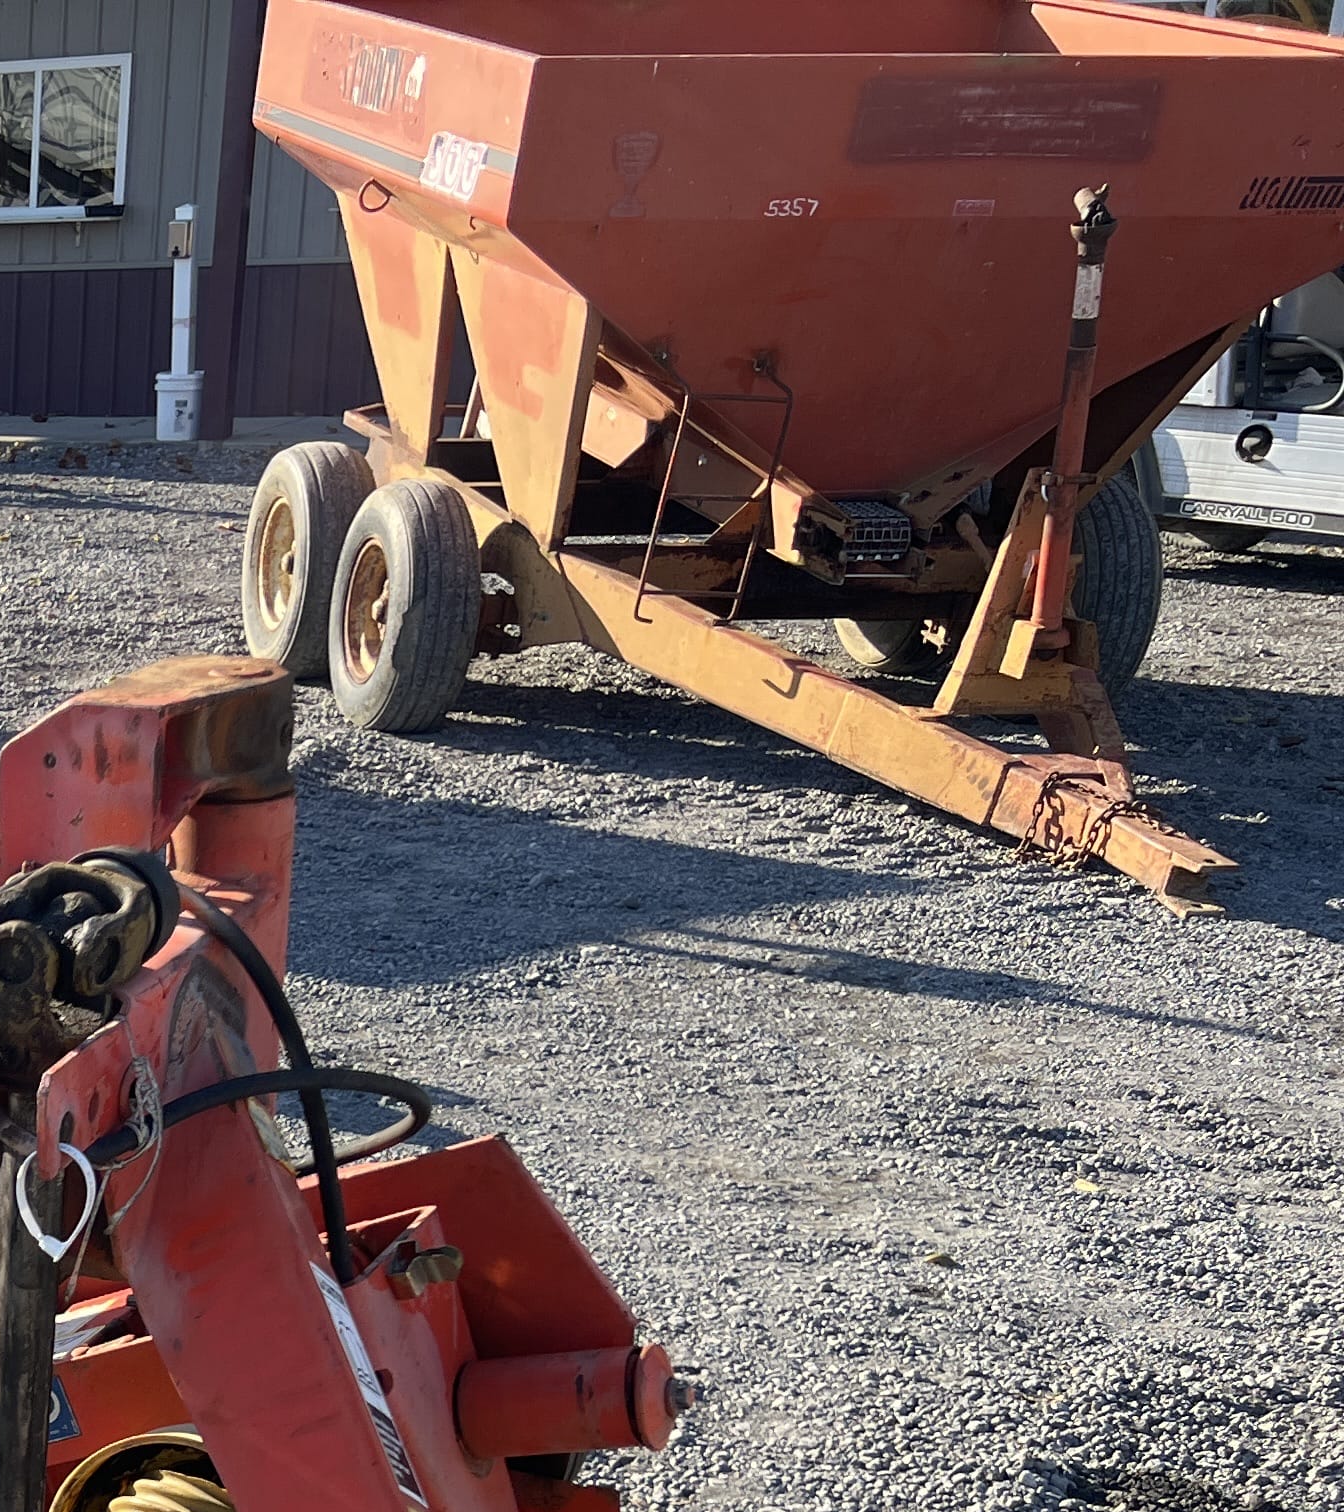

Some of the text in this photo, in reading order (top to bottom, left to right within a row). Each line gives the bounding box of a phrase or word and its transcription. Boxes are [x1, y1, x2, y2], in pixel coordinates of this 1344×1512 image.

[764, 198, 819, 217] 5357
[1181, 501, 1315, 528] CARRYALL 500
